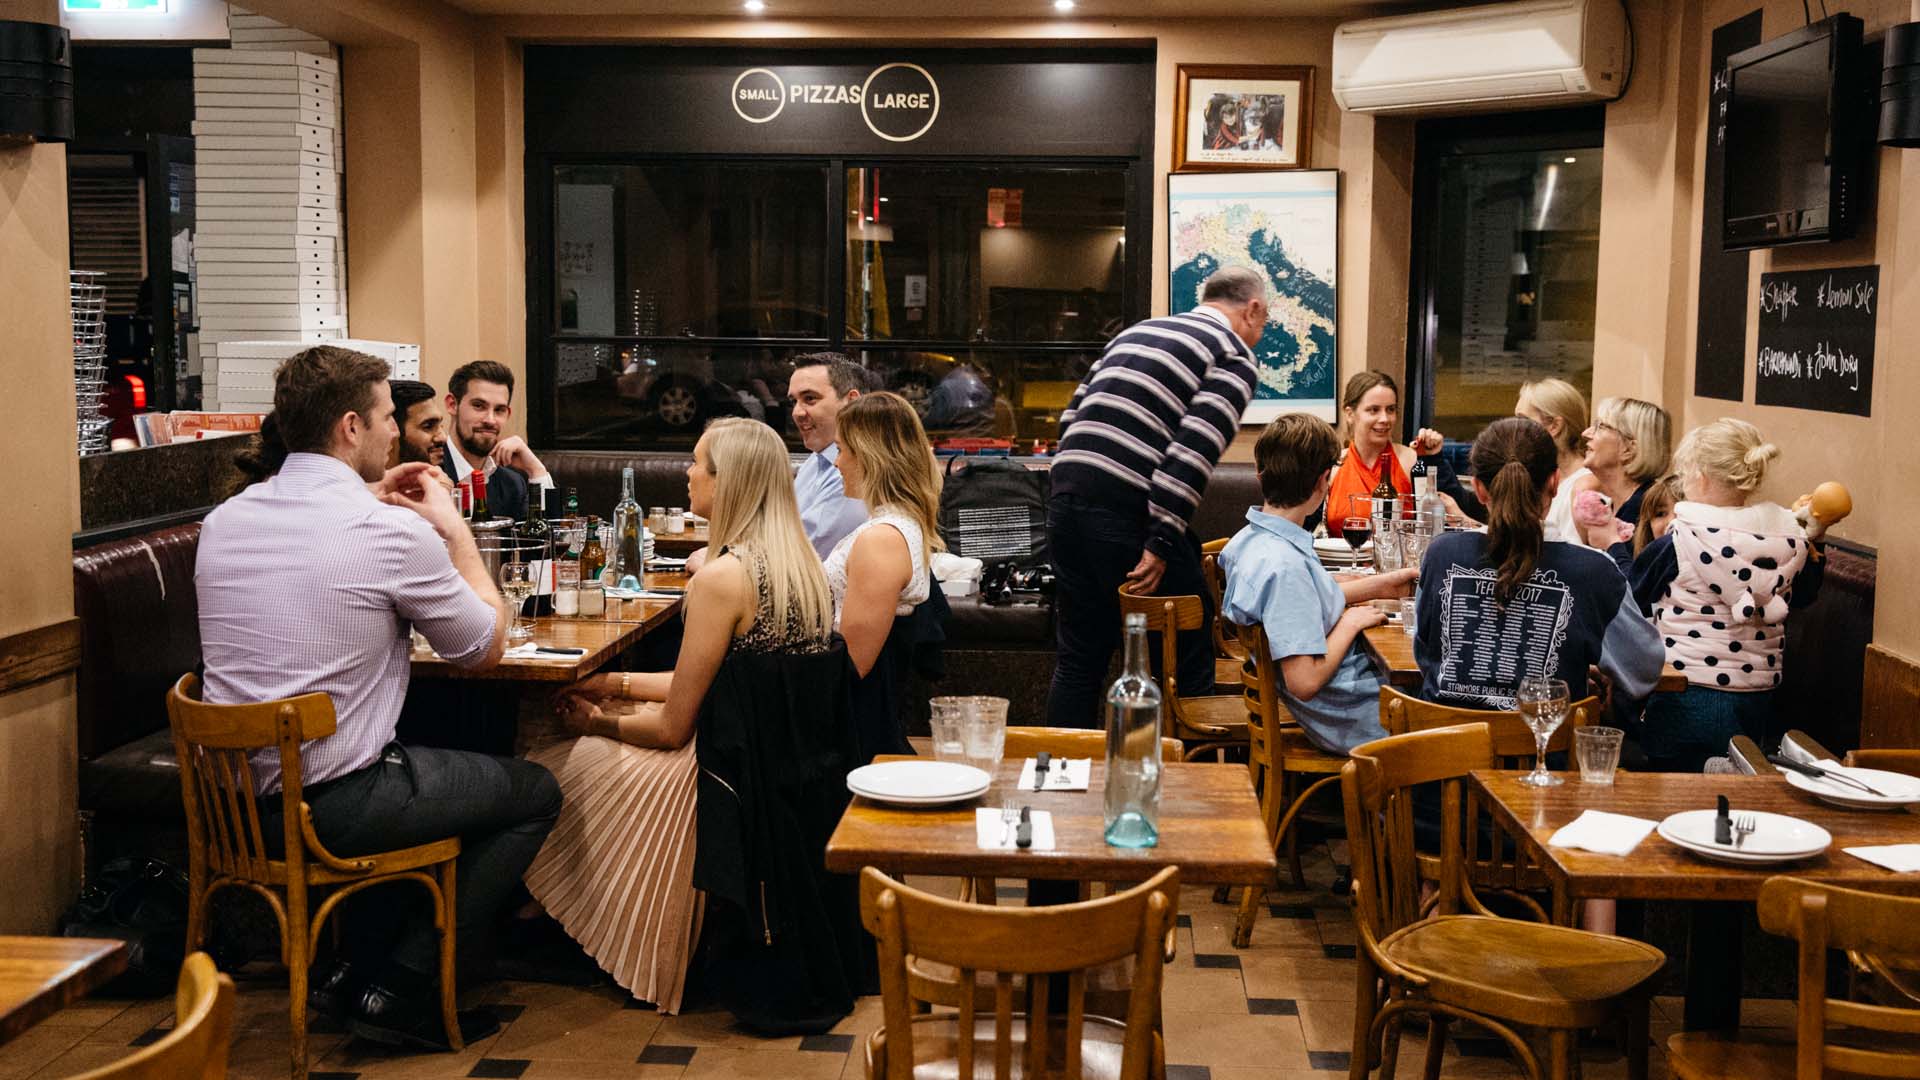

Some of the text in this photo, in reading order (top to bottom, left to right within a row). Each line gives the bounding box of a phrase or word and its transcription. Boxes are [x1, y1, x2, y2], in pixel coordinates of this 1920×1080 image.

[738, 88, 780, 101] SMALL
[790, 84, 861, 104] PIZZAS
[873, 93, 930, 109] LARGE
[1814, 340, 1838, 380] John
[1475, 580, 1543, 602] YEA 2017
[1447, 682, 1480, 695] STANMORE
[1481, 685, 1506, 696] PUBLIC
